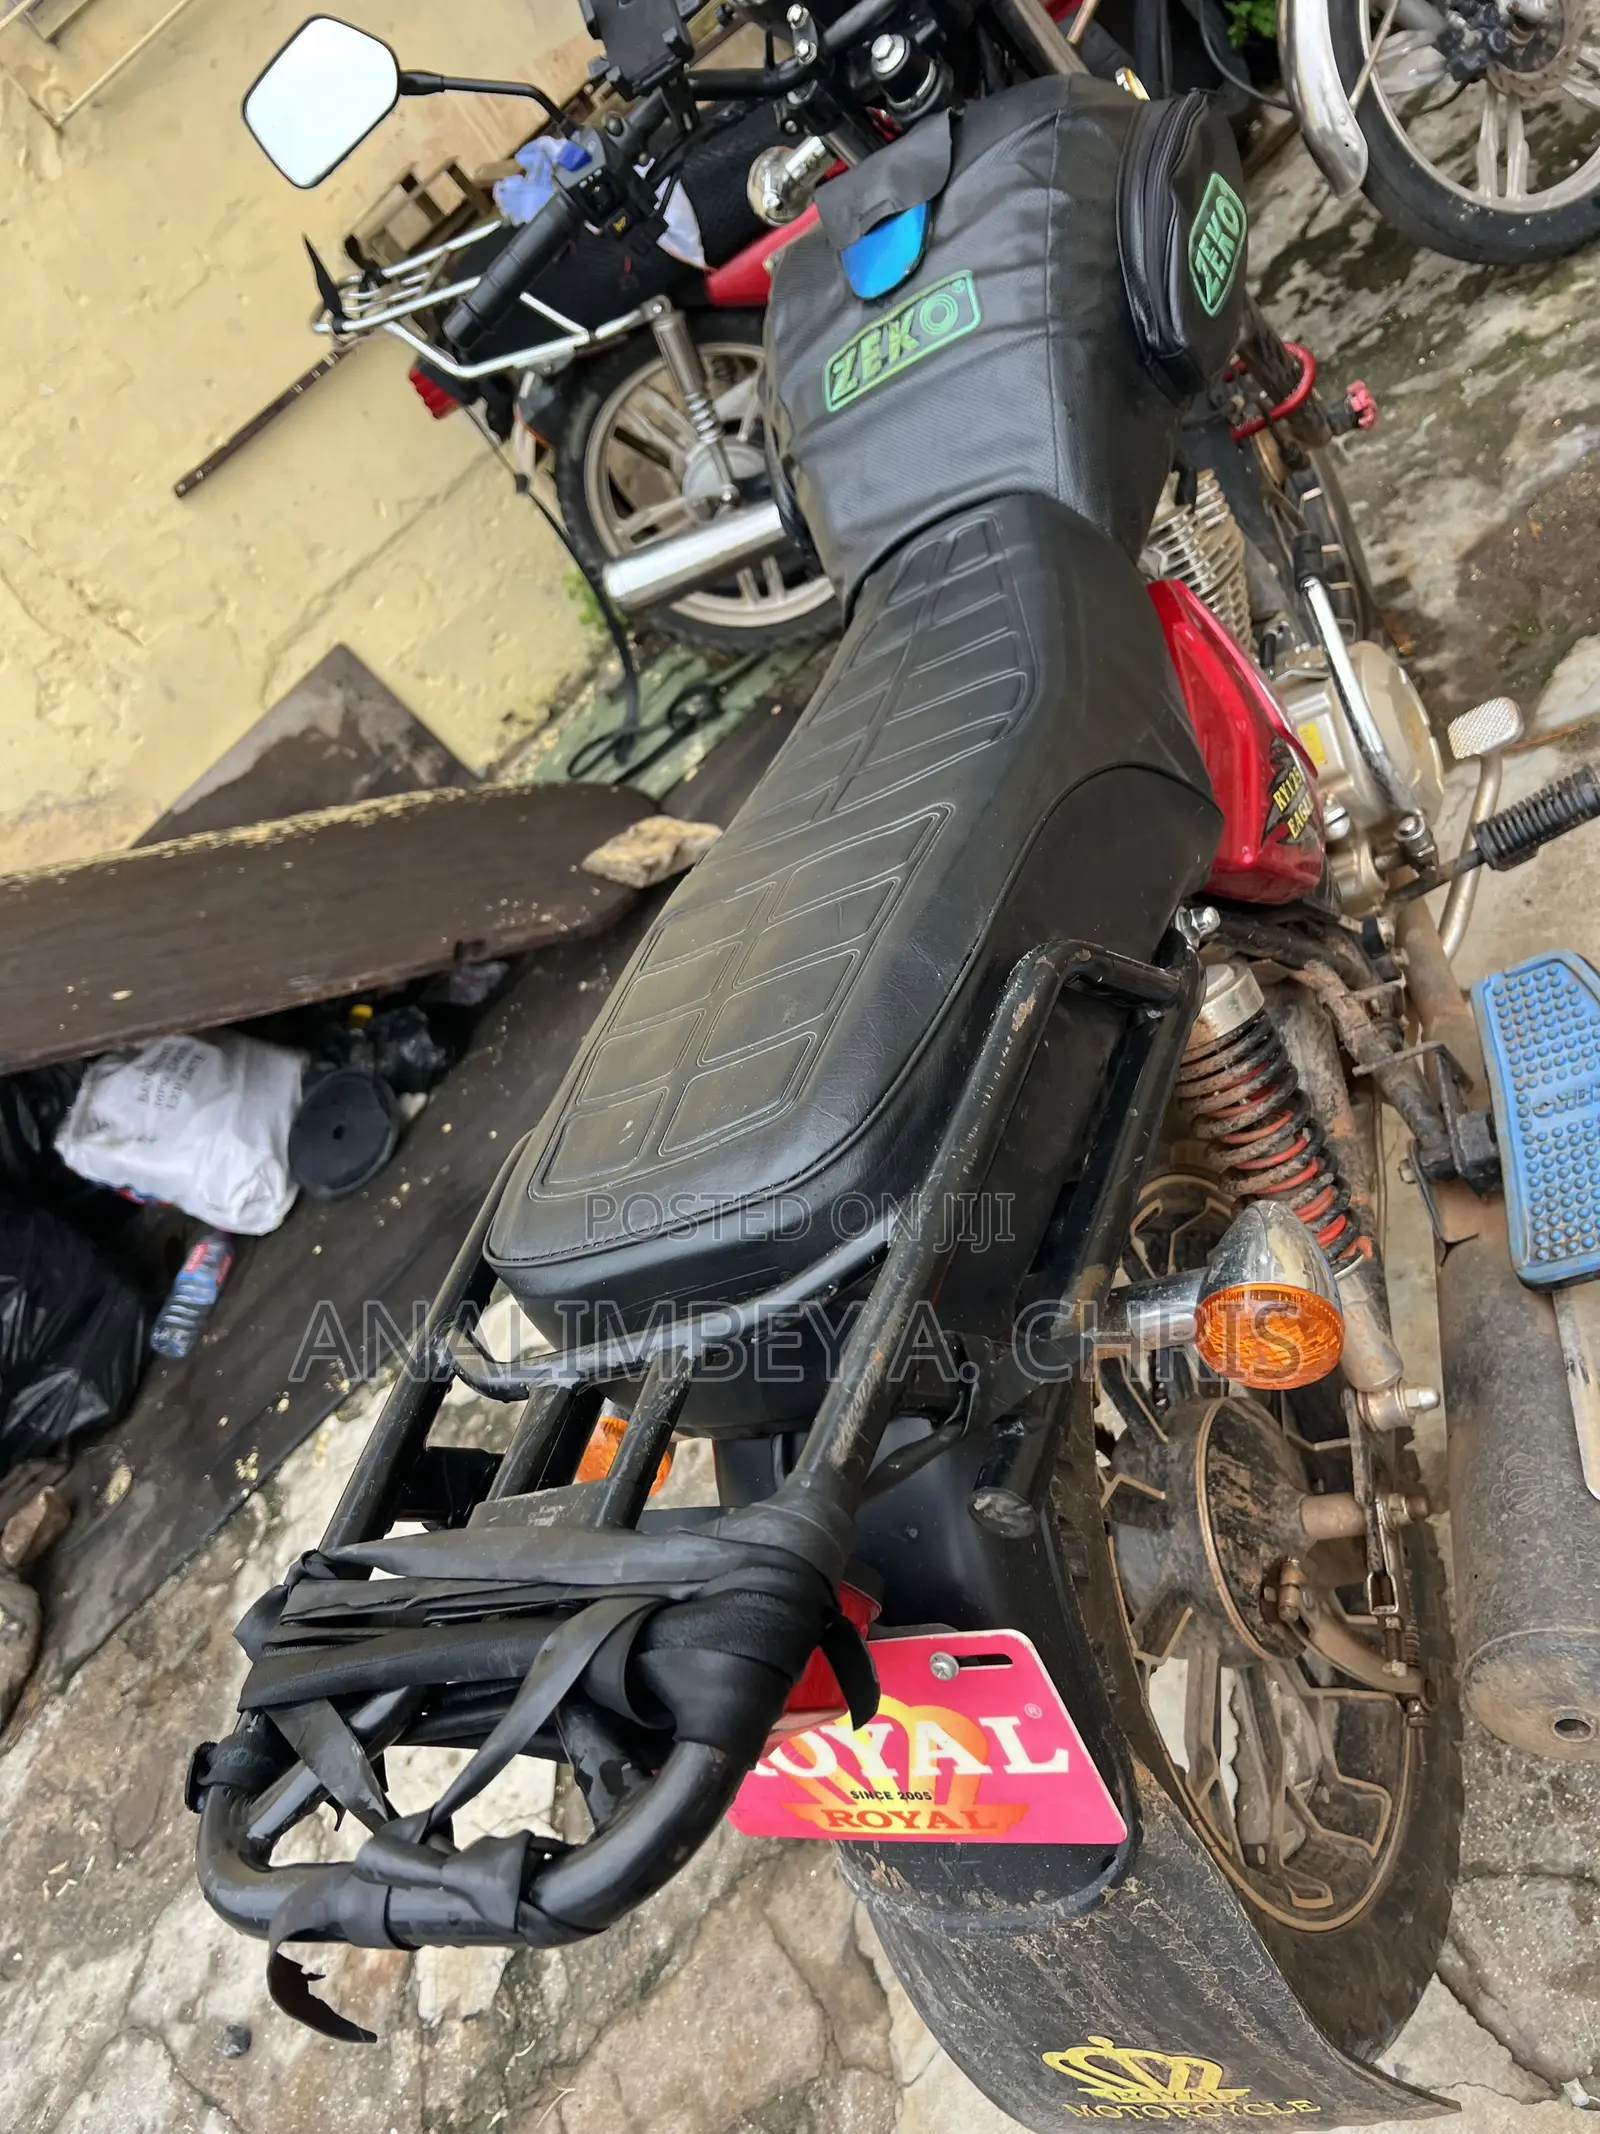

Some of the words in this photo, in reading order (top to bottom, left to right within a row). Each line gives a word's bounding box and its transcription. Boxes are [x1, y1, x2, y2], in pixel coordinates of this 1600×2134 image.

[1195, 195, 1240, 305] ZEKO
[831, 293, 959, 402] ZEKO
[754, 1716, 1069, 1777] OYAL
[850, 1790, 894, 1800] SINCE
[897, 1791, 932, 1801] 2005
[821, 1808, 998, 1830] ROYAL
[1063, 2099, 1321, 2119] MOTORCYCLE
